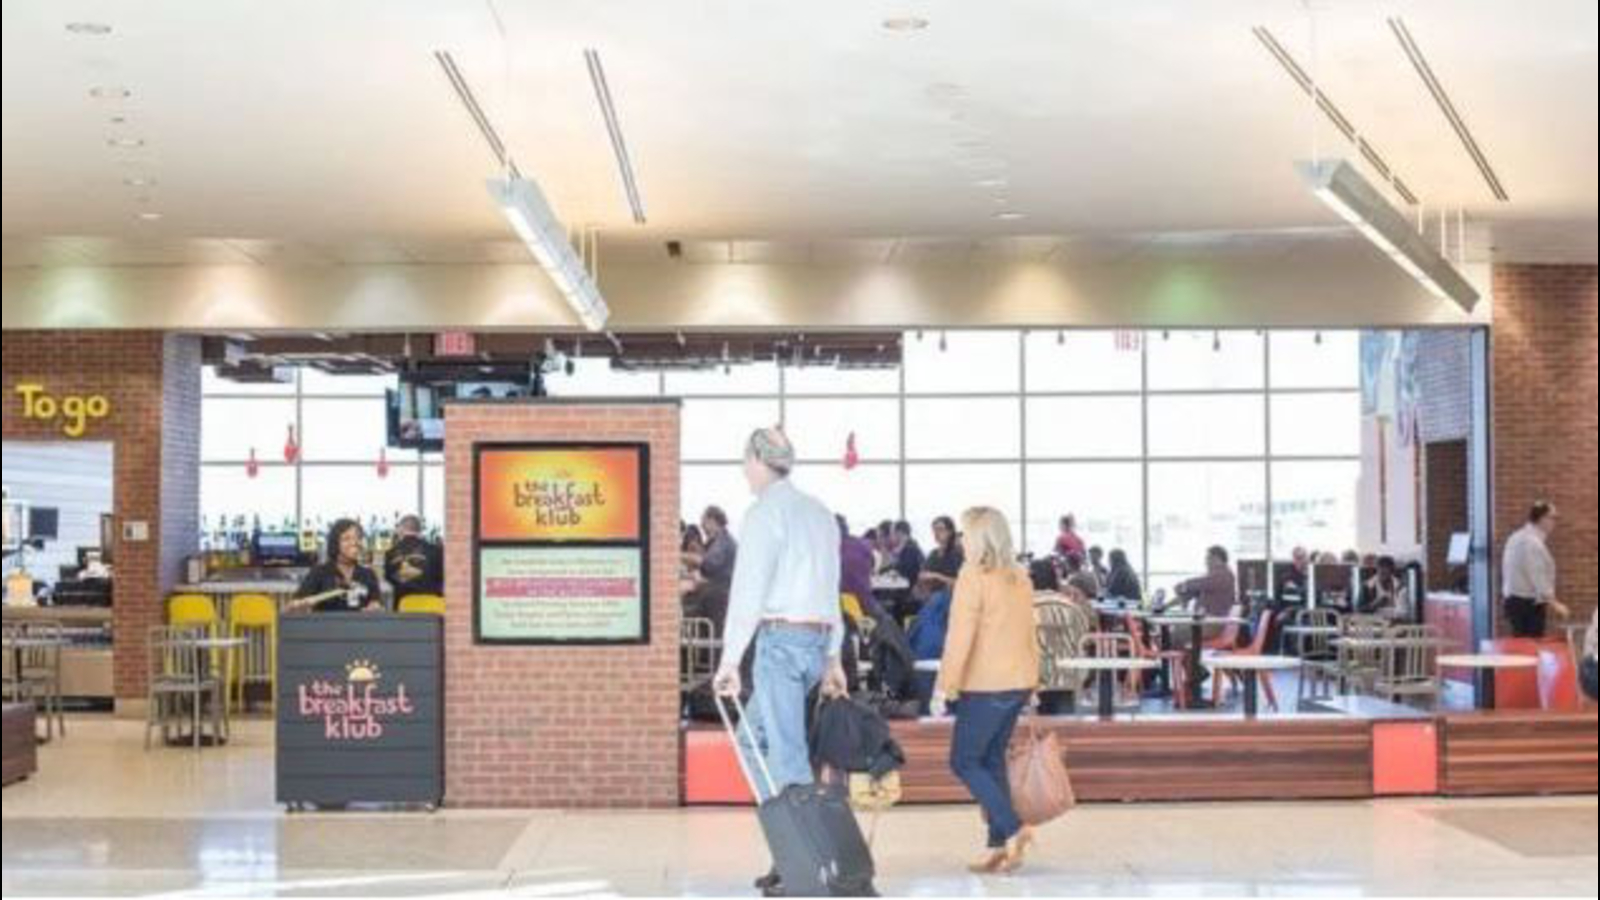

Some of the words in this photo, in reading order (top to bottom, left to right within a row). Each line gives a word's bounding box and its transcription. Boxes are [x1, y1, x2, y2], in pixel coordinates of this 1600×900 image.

[16, 384, 56, 419] To
[62, 395, 109, 437] go
[513, 482, 606, 511] breakfast
[525, 480, 549, 492] the
[535, 509, 582, 526] klub
[312, 680, 343, 696] the
[298, 682, 414, 720] breakfast
[325, 715, 383, 739] klub
